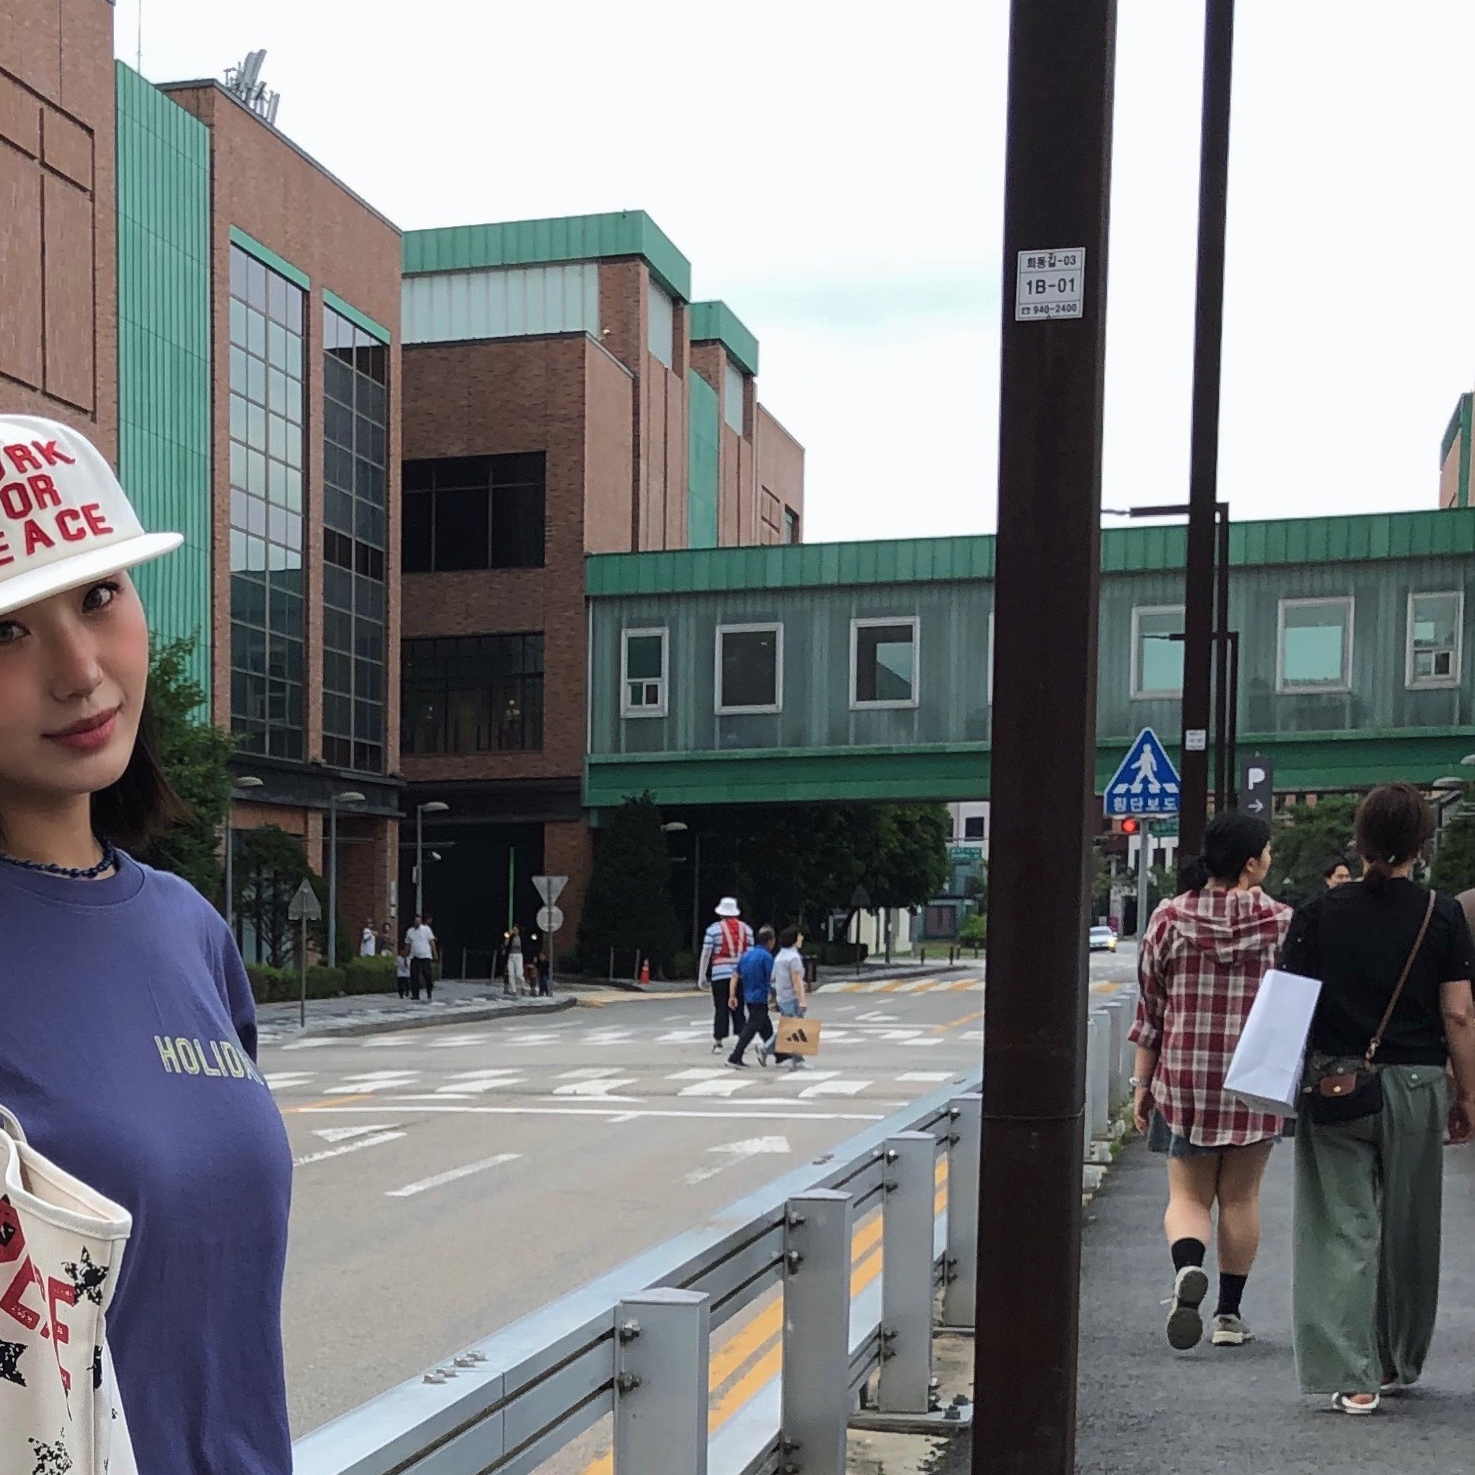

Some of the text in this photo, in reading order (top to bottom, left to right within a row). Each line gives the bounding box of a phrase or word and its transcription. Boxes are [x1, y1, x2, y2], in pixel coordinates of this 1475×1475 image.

[1026, 277, 1075, 295] 1B-01
[1033, 303, 1077, 314] 940-2400
[1248, 768, 1266, 790] P
[1113, 796, 1178, 812] 횡단보도
